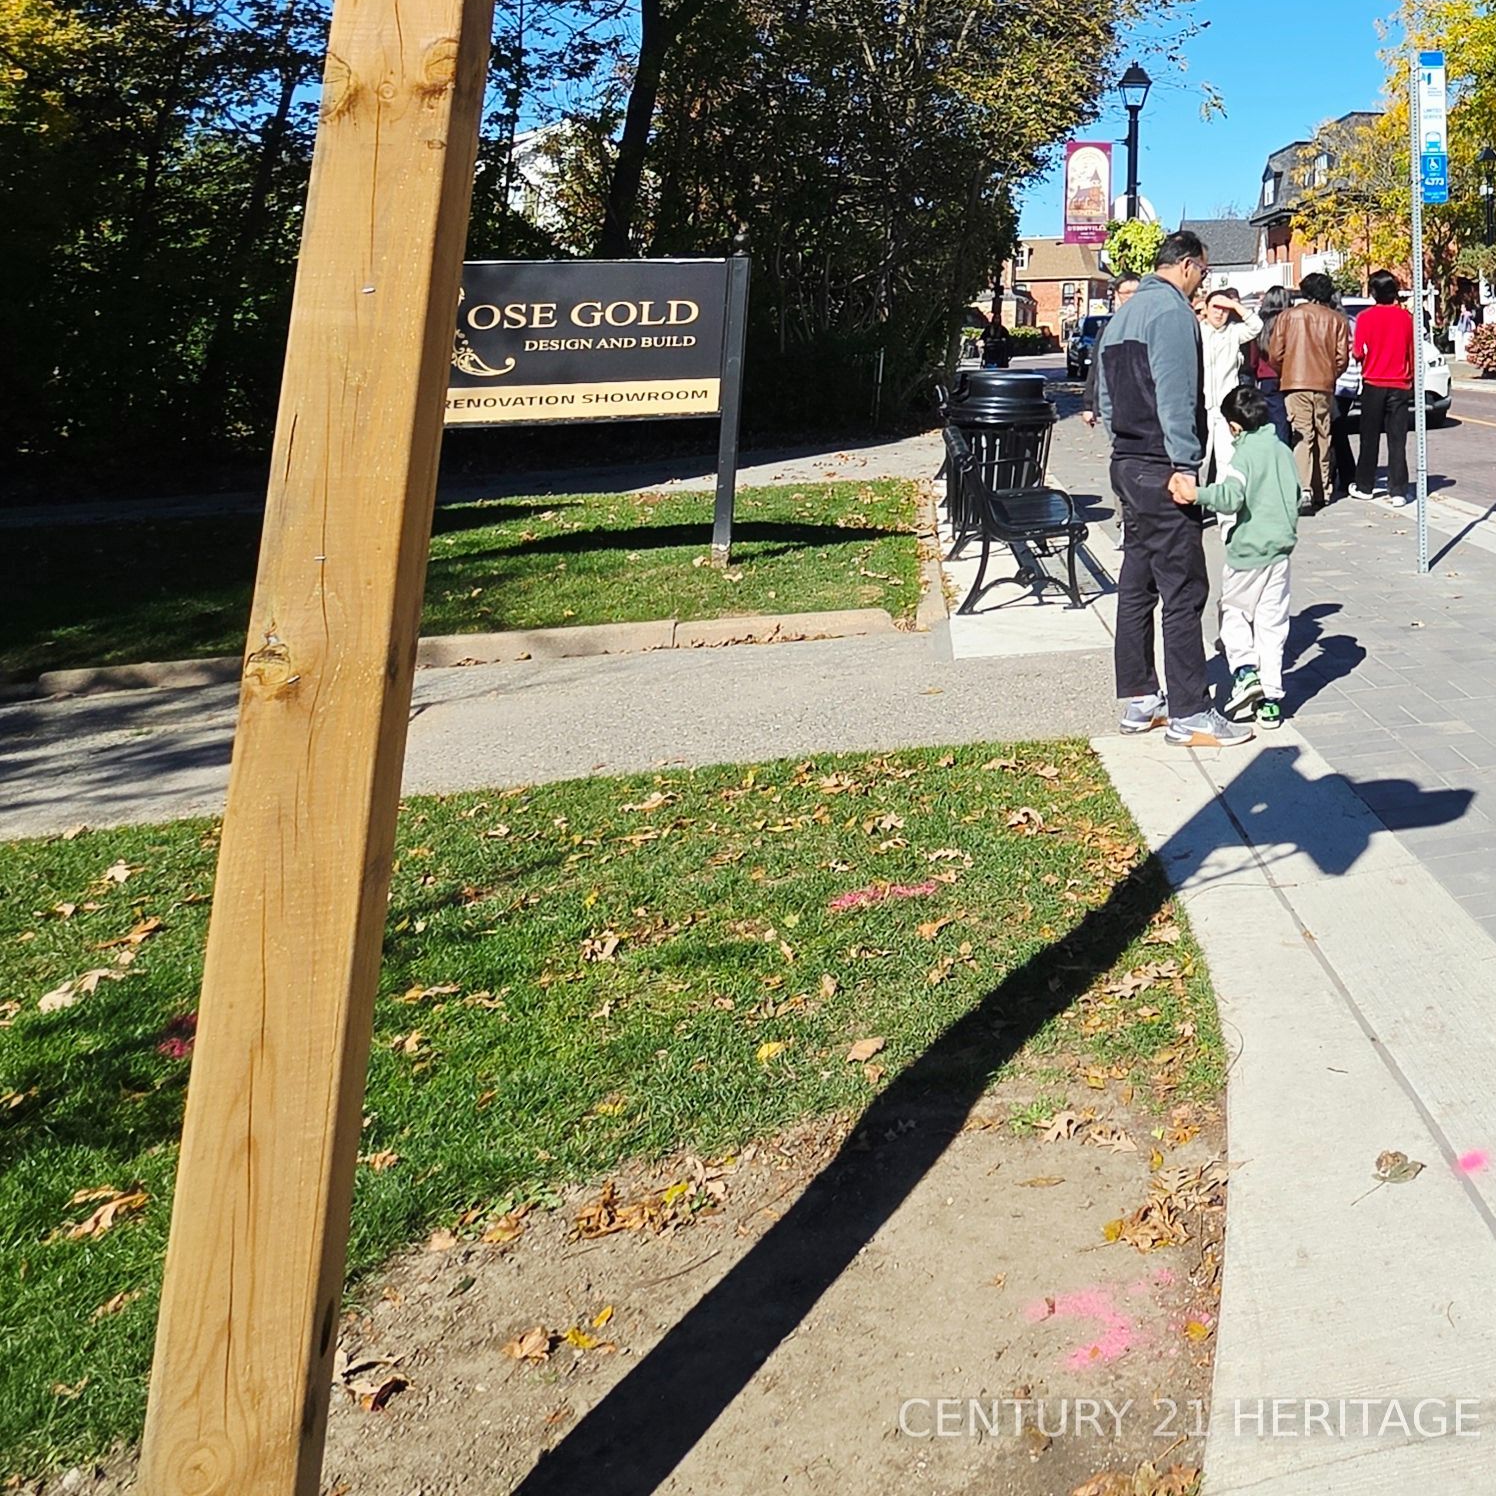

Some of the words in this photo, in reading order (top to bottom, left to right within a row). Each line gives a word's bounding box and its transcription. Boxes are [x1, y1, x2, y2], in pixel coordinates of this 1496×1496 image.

[467, 303, 558, 330] OSE
[570, 299, 700, 328] GOLD
[524, 338, 593, 352] DESIGN
[596, 336, 637, 350] AND
[640, 335, 697, 348] BUILD
[582, 389, 709, 404] SHOWROOM
